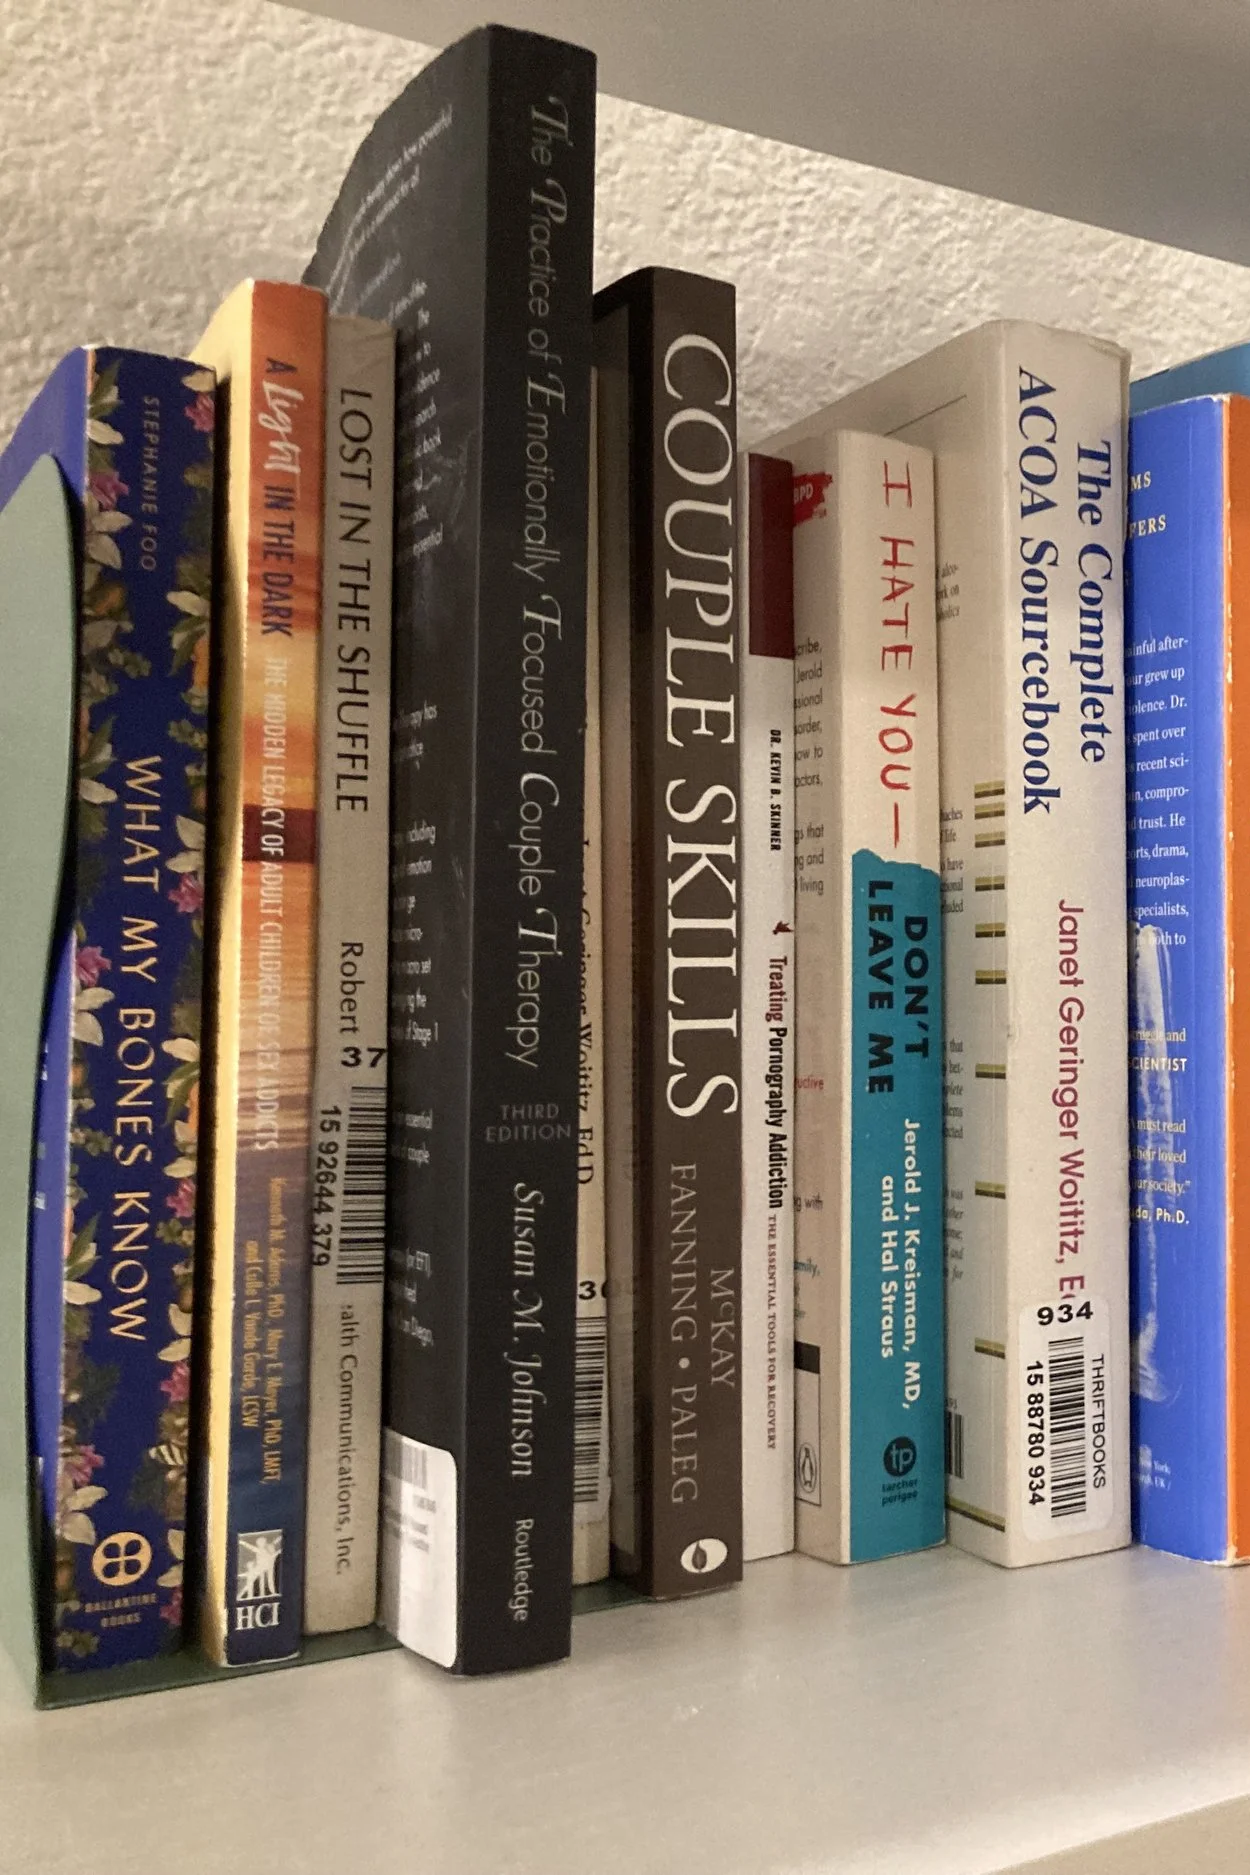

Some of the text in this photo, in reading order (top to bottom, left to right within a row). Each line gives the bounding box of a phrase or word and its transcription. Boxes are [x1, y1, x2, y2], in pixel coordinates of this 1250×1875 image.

[141, 396, 160, 571] STEPHANIE FOO
[258, 358, 304, 638] A Light IN THE DARK
[883, 461, 912, 508] I
[336, 389, 373, 812] LOST IN THE SHUFFLE
[505, 96, 573, 1068] The Practice of Emotionally Focused Couple Therapy
[880, 536, 914, 671] HATE
[1019, 366, 1061, 815] ACOA Sourcebook
[1070, 440, 1114, 762] The Complete
[263, 693, 287, 759] HIDDEN
[264, 657, 288, 689] THE
[663, 334, 739, 1117] COUPLE SKILLS
[260, 833, 284, 857] OF
[261, 765, 286, 830] LEGACY
[770, 729, 782, 852] DR. KEVIN B. SKINNER
[259, 860, 284, 919] ADULT
[1134, 903, 1189, 919] specialists,
[257, 921, 283, 1006] CHILDREN
[339, 942, 364, 1035] Robert
[867, 880, 894, 1094] LEAVE ME
[904, 915, 930, 1058] DON'T
[110, 755, 163, 1341] WHAT MY BONES KNOW
[501, 1102, 559, 1120] THIRD
[765, 956, 789, 1209] Treating Pornography Addiction
[1052, 900, 1085, 1264] Janet Geringer Woititz,
[486, 1124, 571, 1143] EDITION
[504, 1182, 547, 1478] Susan M. Johnson
[671, 1164, 698, 1504] FANNING PALEG
[767, 1214, 777, 1449] THE ESSENTIAL TOOLS FOR RECOVERY
[881, 1175, 898, 1359] and Hal Straus
[902, 1119, 921, 1410] Jerold J. Kreisman, MD,
[1036, 1301, 1094, 1326] 934
[337, 1352, 358, 1575] Communications, Inc.
[1026, 1361, 1045, 1506] 15 88780 934
[1091, 1354, 1105, 1489] THRIFTBOOKS
[236, 1602, 279, 1631] HCI
[508, 1518, 534, 1622] Routledge
